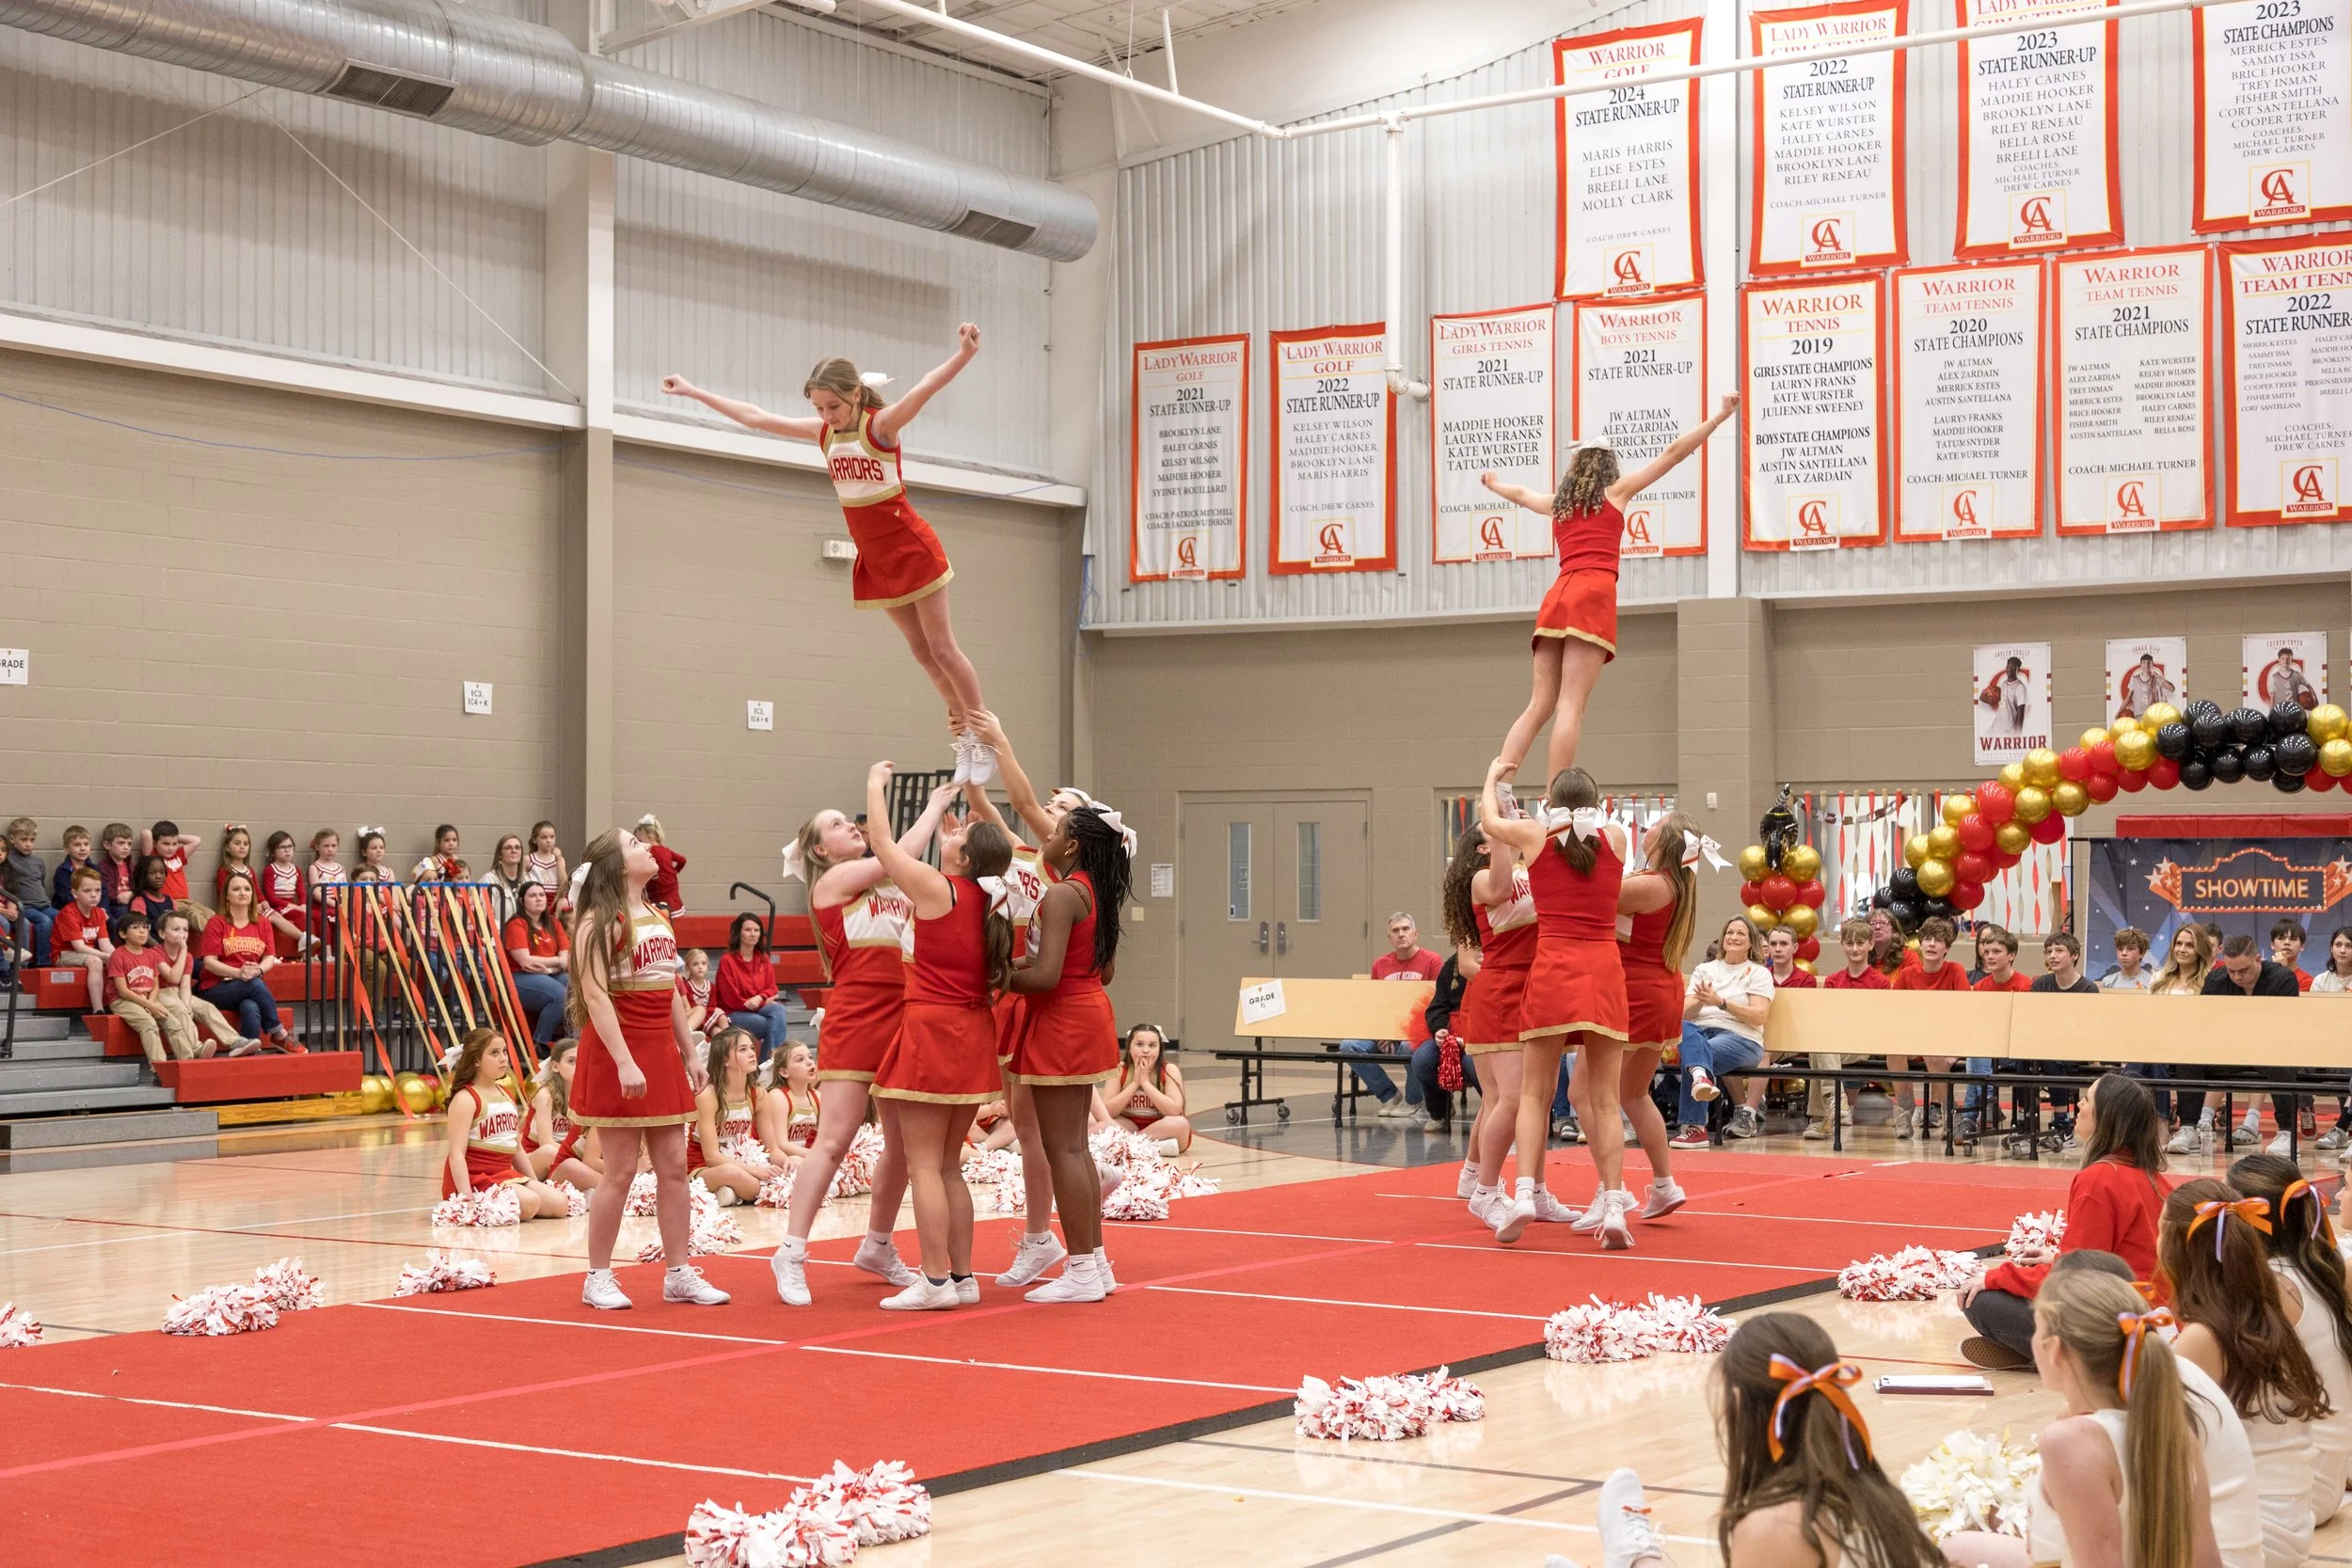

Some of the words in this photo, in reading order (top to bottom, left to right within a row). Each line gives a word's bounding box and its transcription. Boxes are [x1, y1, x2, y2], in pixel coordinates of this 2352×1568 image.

[2256, 0, 2300, 20] 2023
[1772, 27, 1815, 42] LADY
[1816, 18, 1886, 36] WARRIOR
[2224, 25, 2259, 44] STATE
[2261, 16, 2333, 40] CHAMPIONS
[2017, 31, 2058, 52] 2023
[2230, 40, 2286, 56] MERRICK
[2291, 36, 2328, 49] ESTES
[1589, 44, 1664, 65] WARRIOR
[1979, 56, 2018, 75] STATE
[2021, 47, 2096, 70] RUNNER-UP
[2242, 54, 2286, 66] SAMMY
[2291, 50, 2315, 61] ISSA
[1810, 59, 1848, 76] 2022
[2232, 69, 2267, 80] BRICE
[2271, 61, 2326, 75] HOOKER
[1609, 86, 1645, 104] 2024
[1784, 83, 1814, 100] STATE
[1816, 76, 1874, 96] RUNNER-UP
[1576, 108, 1610, 127] STATE
[1610, 98, 1679, 121] RUNNER-UP
[1582, 149, 1620, 162] MARIS
[1628, 140, 1673, 156] HARRIS
[1590, 164, 1622, 178] ELISE
[1629, 159, 1665, 172] ESTES
[1588, 179, 1629, 194] BREELI
[1636, 174, 1668, 188] LANE
[1582, 197, 1623, 211] MOLLY
[1631, 190, 1673, 204] CLARK
[2256, 207, 2303, 215] WARRIORS
[2083, 264, 2180, 283] WARRIOR
[1610, 283, 1649, 293] WARRIORS
[1922, 278, 2015, 296] WARRIOR
[2086, 288, 2123, 301] TEAM
[2128, 284, 2178, 297] TENNIS
[2240, 277, 2297, 293] TEAM
[1762, 294, 1863, 316] WARRIOR
[1926, 301, 1961, 313] TEAM
[1966, 298, 2013, 309] TENNIS
[2287, 293, 2331, 312] 2022
[1598, 311, 1681, 327] WARRIOR
[2113, 306, 2149, 322] 2021
[1439, 325, 1476, 340] LADY
[1478, 320, 1546, 336] WARRIOR
[1788, 319, 1839, 332] TENNIS
[1950, 318, 1987, 334] 2020
[2075, 325, 2112, 341] STATE
[2115, 319, 2188, 337] CHAMPIONS
[2246, 317, 2289, 335] STATE
[1601, 334, 1630, 345] BOYS
[1633, 329, 1677, 342] TENNIS
[1915, 337, 1949, 352] STATE
[1952, 332, 2023, 349] CHAMPIONS
[1286, 346, 1323, 362] LADY
[1323, 341, 1382, 356] WARRIOR
[1453, 344, 1486, 355] GIRLS
[1489, 340, 1533, 351] TENNIS
[1791, 338, 1833, 355] 2019
[1144, 356, 1178, 371] LADY
[1178, 352, 1237, 367] WARRIOR
[1624, 349, 1656, 364] 2021
[1313, 361, 1353, 373] GOLF
[1477, 359, 1507, 373] 2021
[1588, 367, 1623, 381] STATE
[1626, 361, 1692, 378] RUNNER-UP
[1754, 367, 1780, 377] GIRLS
[1782, 363, 1811, 375] STATE
[1814, 357, 1873, 373] CHAMPIONS
[1176, 372, 1203, 382] GOLF
[1317, 378, 1349, 393] 2022
[1443, 376, 1476, 390] STATE
[1479, 371, 1543, 388] RUNNER-UP
[1772, 379, 1811, 390] LAURYN
[1815, 376, 1856, 388] FRANKS
[1177, 388, 1203, 402] 2021
[1287, 397, 1317, 414] STATE
[1320, 392, 1379, 411] RUNNER-UP
[1773, 392, 1798, 404] KATE
[1802, 388, 1853, 401] WURSTER
[1150, 404, 1177, 417] STATE
[1179, 400, 1231, 414] RUNNER-UP
[1610, 412, 1621, 423] JW
[1627, 408, 1670, 420] ALTMAN
[1761, 404, 1813, 420] JULIENNE
[1816, 401, 1863, 413] SWEENEY
[1293, 422, 1328, 432] KELSEY
[1332, 420, 1373, 428] WILSON
[1443, 420, 1489, 433] MADDIE
[1494, 415, 1543, 428] HOOKER
[1602, 424, 1628, 435] ALEX
[1630, 420, 1677, 433] ZARDIAN
[1295, 435, 1327, 444] HALEY
[1330, 431, 1371, 442] CARNES
[1445, 432, 1492, 445] LAURYN
[1496, 429, 1541, 441] FRANKS
[1756, 434, 1779, 445] BOYS
[1781, 432, 1809, 443] STATE
[1811, 426, 1870, 441] CHAMPIONS
[1289, 447, 1329, 456] MADDIE
[1332, 443, 1377, 454] HOOKER
[1449, 446, 1479, 458] KATE
[1482, 442, 1538, 455] WURSTER
[1781, 448, 1794, 459] JW
[1801, 445, 1843, 456] ALTMAN
[828, 457, 885, 482] ARRIORS
[1290, 458, 1345, 468] BROOKLYN
[1349, 454, 1375, 466] LANE
[1447, 458, 1489, 470] TATUM
[1493, 455, 1539, 467] SNYDER
[1759, 461, 1796, 472] AUSTIN
[1800, 456, 1867, 469] SANTELLANA
[2069, 465, 2106, 474] COACH:
[2109, 462, 2153, 472] MICHAEL
[2156, 459, 2196, 469] TURNER
[1298, 471, 1328, 481] MARIS
[1331, 468, 1368, 479] HARRIS
[1775, 474, 1801, 484] ALEX
[1804, 471, 1851, 483] ZARDAIN
[2113, 519, 2153, 529] WARRIORS
[0, 658, 24, 669] RADE
[1980, 735, 2047, 751] WARRIOR
[2195, 879, 2309, 898] SHOWTIME
[223, 936, 266, 957] WARRIORS
[632, 937, 676, 973] WARRIOR
[1249, 992, 1275, 1005] GRADE
[479, 1113, 517, 1140] WARRIO
